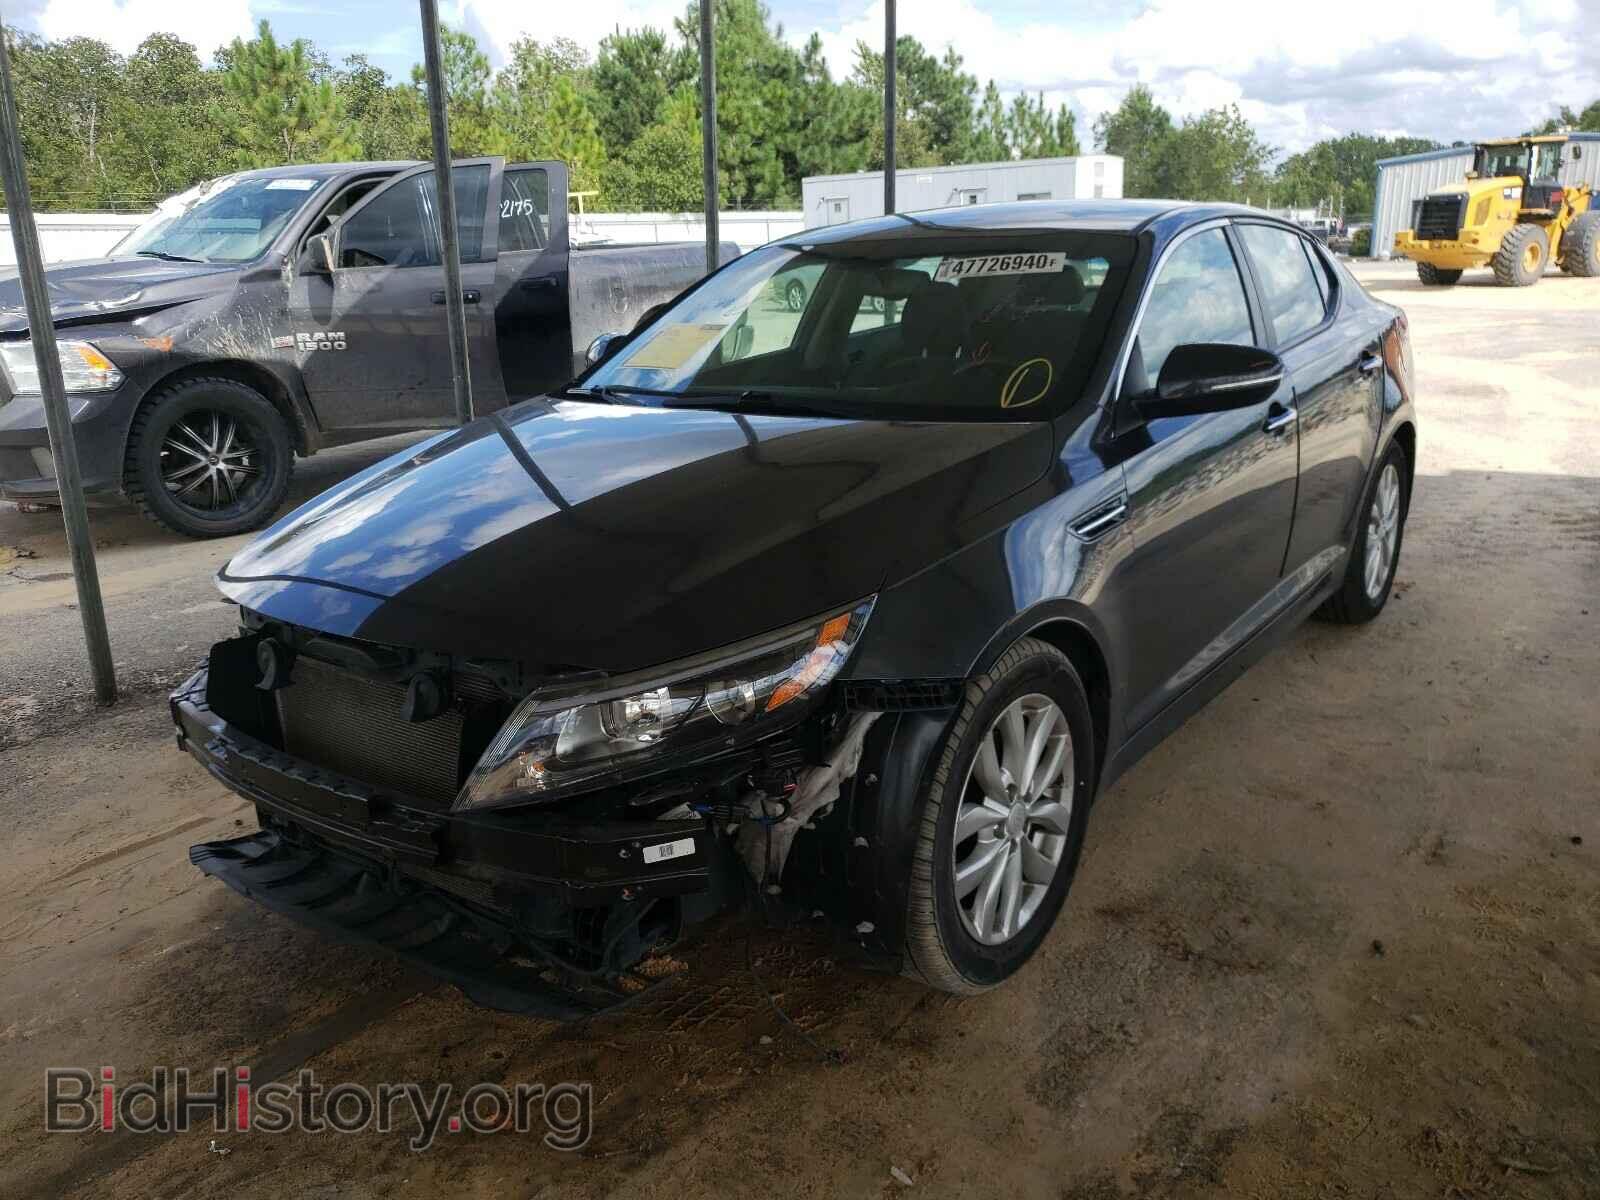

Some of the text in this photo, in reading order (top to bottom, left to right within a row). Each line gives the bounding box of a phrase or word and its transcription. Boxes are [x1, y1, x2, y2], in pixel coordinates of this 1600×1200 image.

[500, 199, 533, 218] 2175
[296, 332, 345, 342] RAM
[298, 341, 347, 352] 1500
